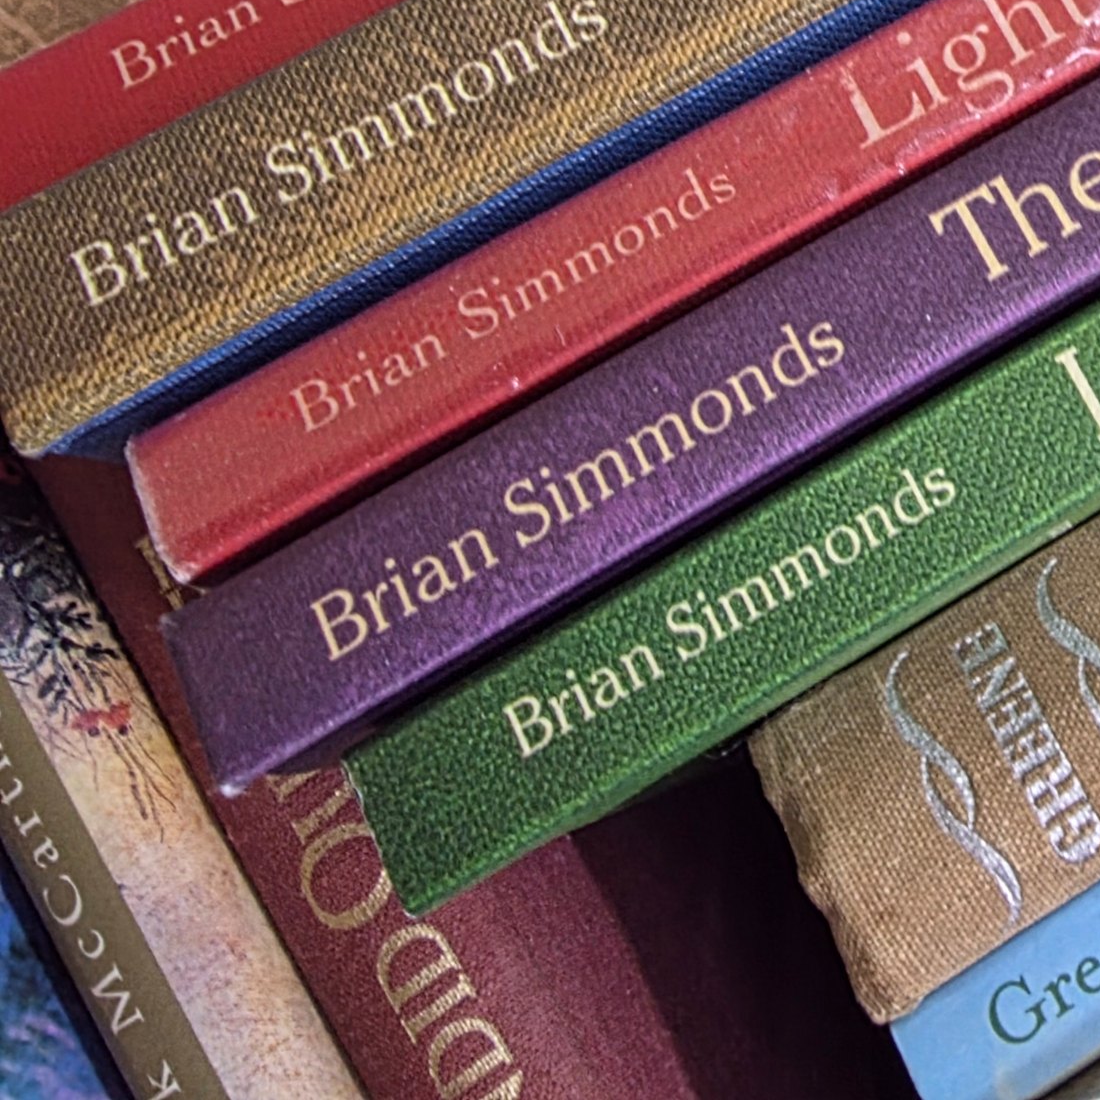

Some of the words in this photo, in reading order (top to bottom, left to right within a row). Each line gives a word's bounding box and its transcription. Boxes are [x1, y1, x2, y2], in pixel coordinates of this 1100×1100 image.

[67, 184, 258, 308] Brian
[290, 331, 447, 434] Brian
[456, 165, 737, 341] Simmonds
[309, 526, 500, 662] Brian
[503, 317, 845, 547] Simmonds
[503, 644, 664, 759] Brian
[666, 462, 956, 664] Simmonds
[0, 742, 144, 1036] McCart
[373, 923, 524, 1100] DID
